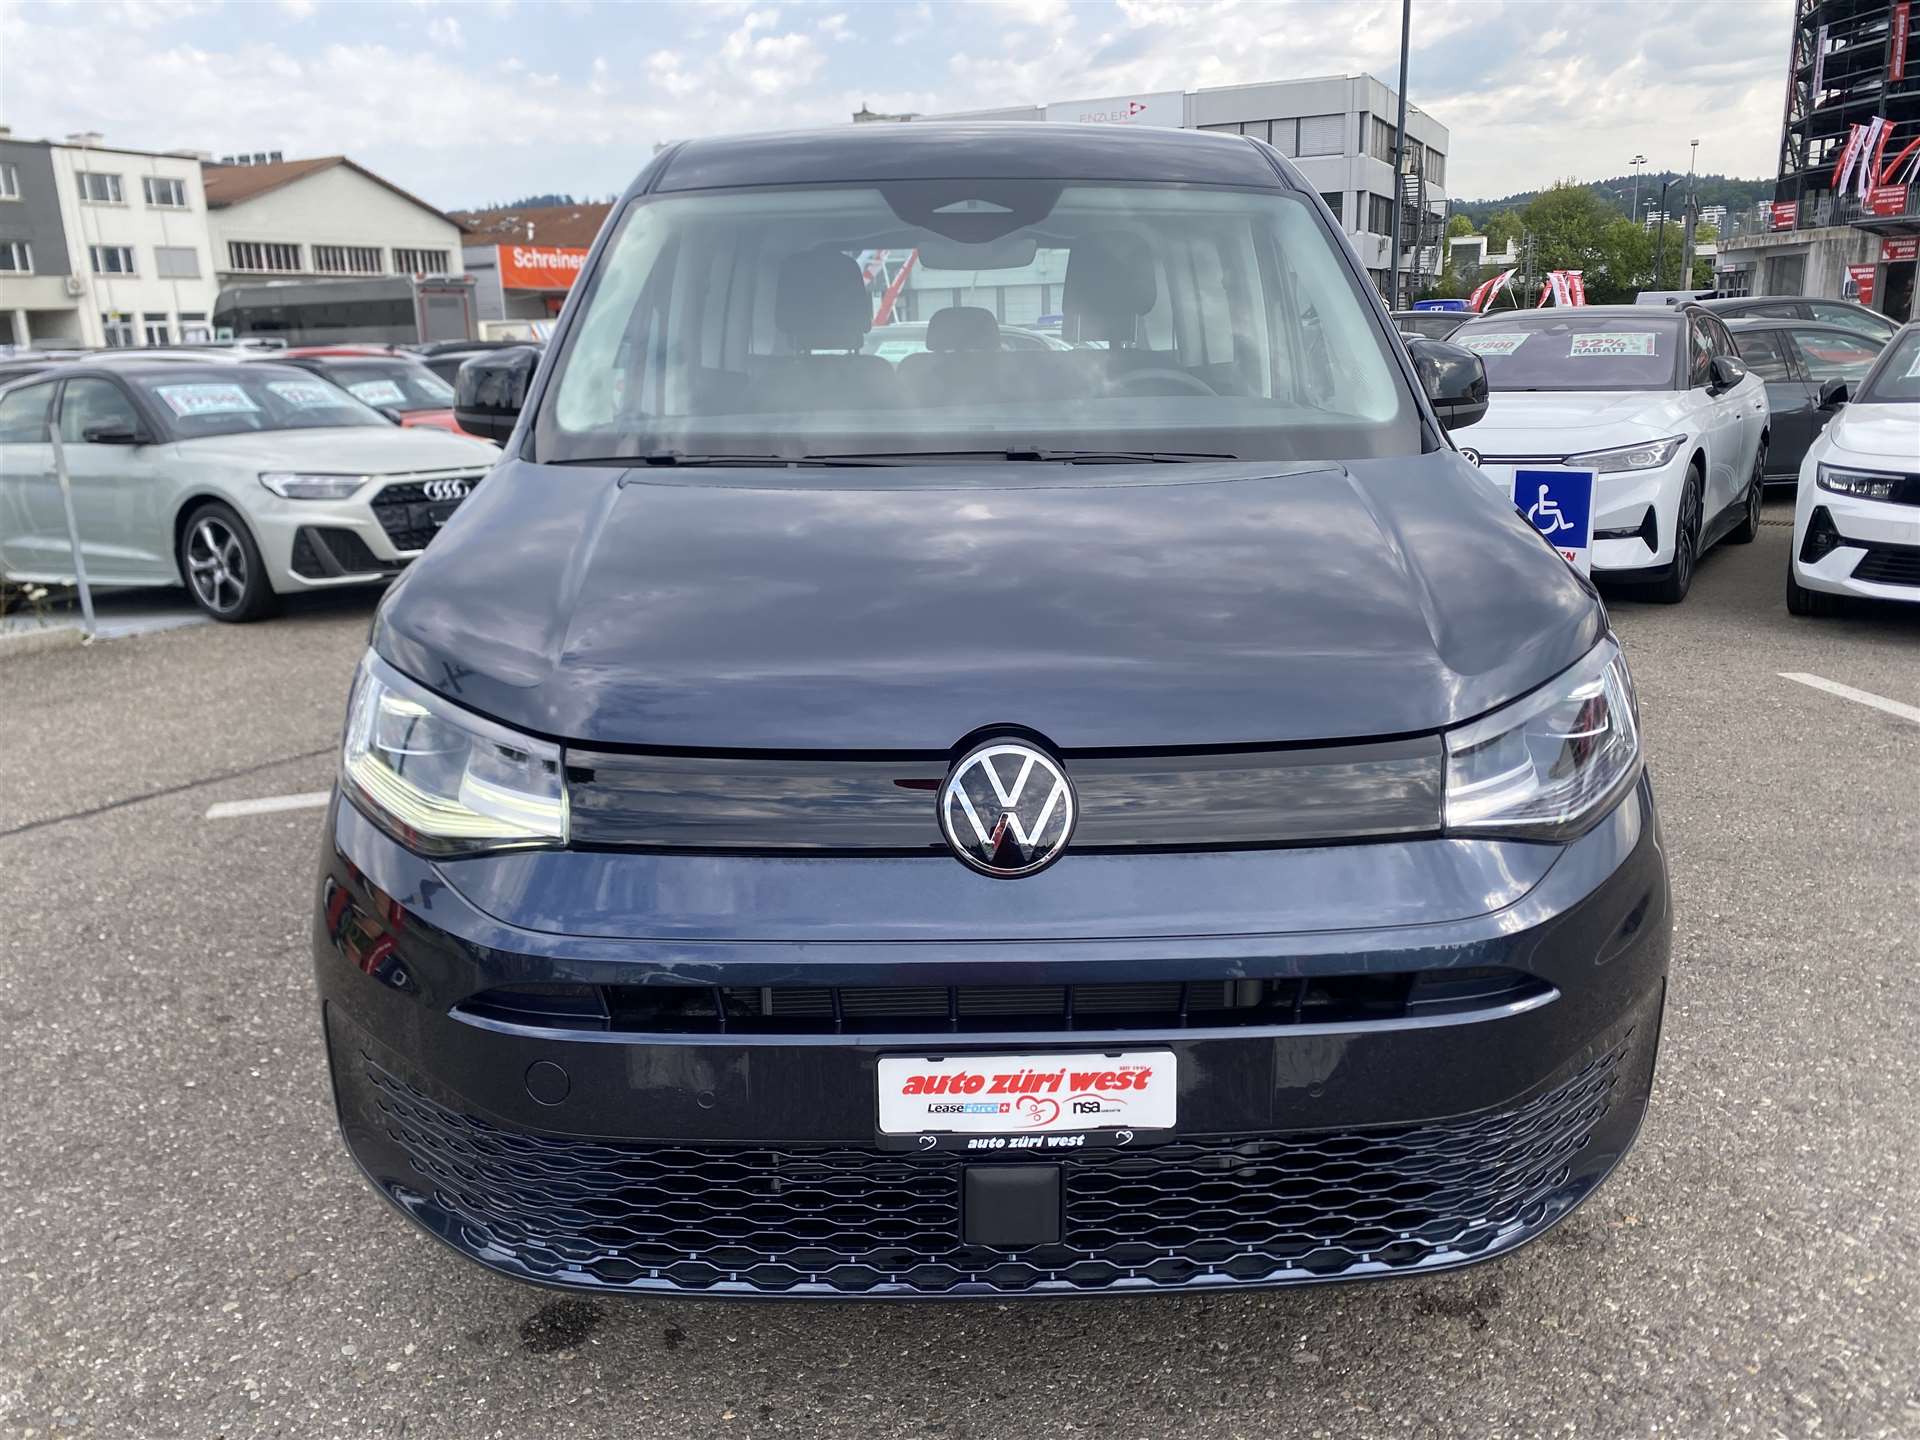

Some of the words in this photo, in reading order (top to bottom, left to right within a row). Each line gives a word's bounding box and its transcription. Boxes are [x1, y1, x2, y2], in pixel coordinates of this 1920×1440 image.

[1079, 111, 1129, 123] ENZLER
[1574, 337, 1627, 348] 32%
[1573, 346, 1626, 354] RABATT
[902, 1070, 985, 1095] auto
[986, 1067, 1066, 1094] züri
[1070, 1067, 1152, 1092] west
[1073, 1101, 1101, 1114] nsa
[967, 1137, 1006, 1149] auto
[1008, 1135, 1045, 1148] züri
[1047, 1134, 1086, 1147] west
